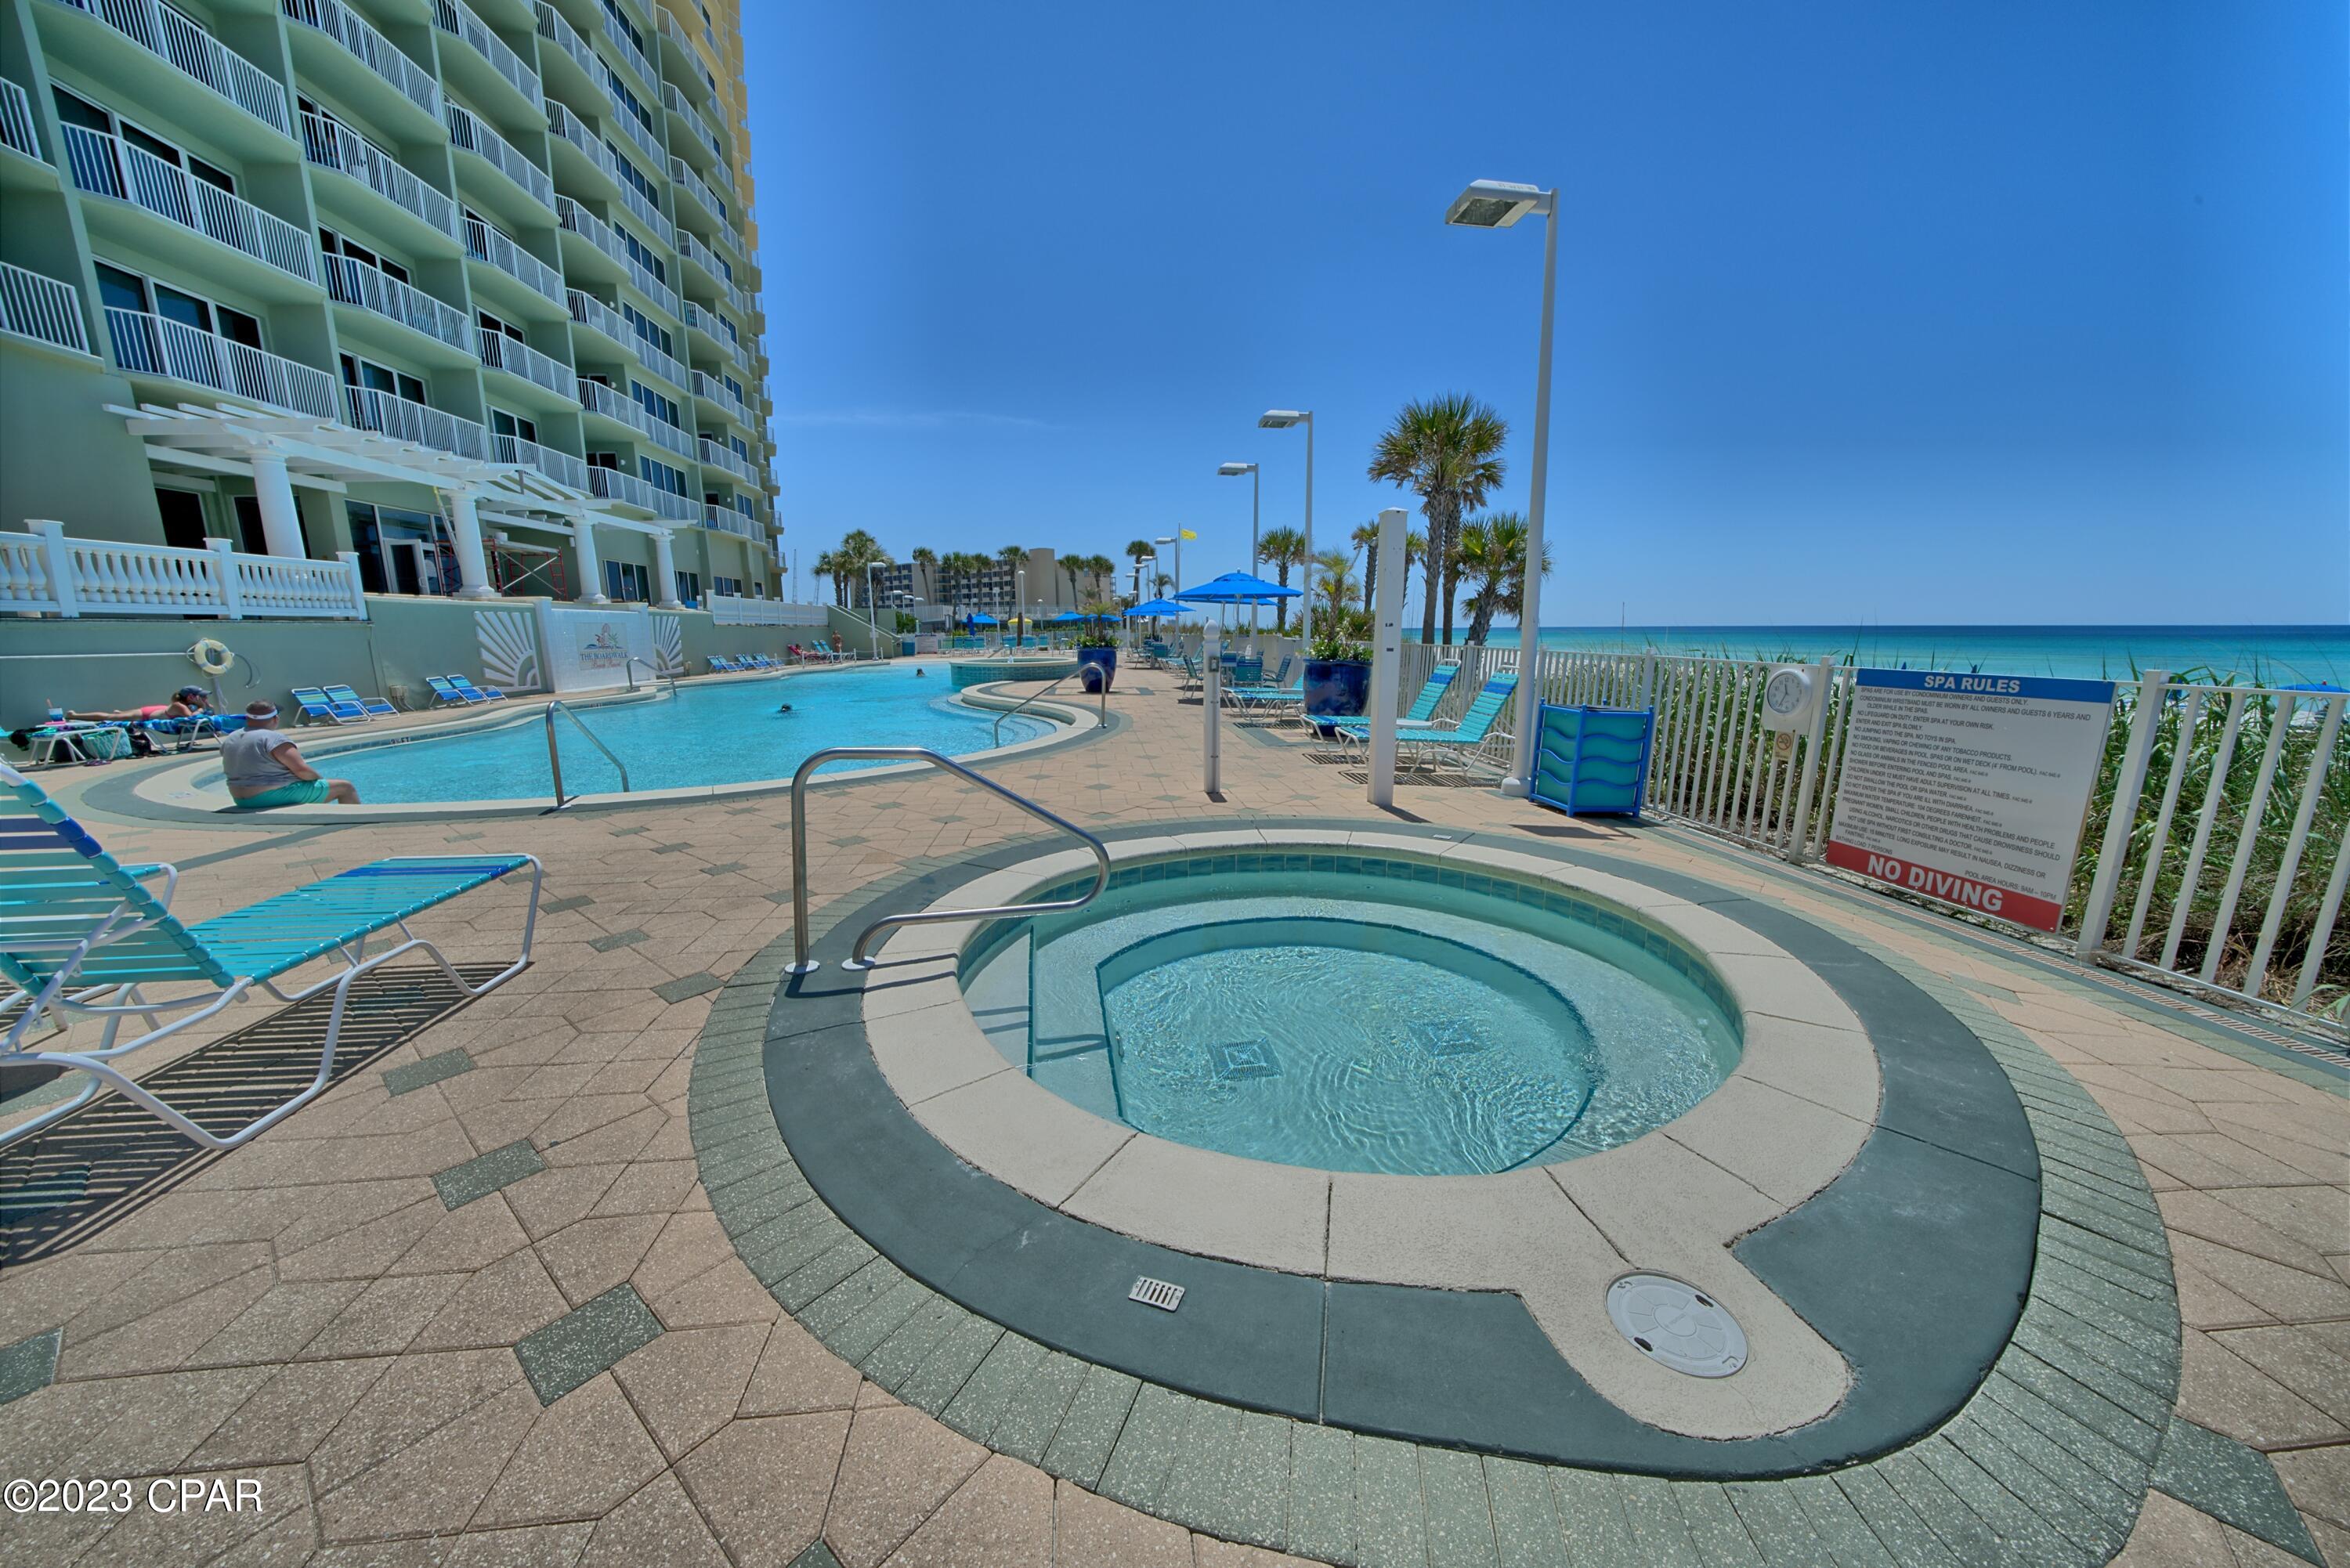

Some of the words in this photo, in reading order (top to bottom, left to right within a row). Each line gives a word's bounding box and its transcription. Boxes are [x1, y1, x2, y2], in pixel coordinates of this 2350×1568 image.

[1924, 674, 1956, 690] SPA
[1961, 677, 2021, 694] RULES
[1879, 746, 1907, 755] BEVERAGES
[1908, 741, 1932, 750] CHEWING
[1952, 747, 1979, 756] TOBACCO
[1979, 751, 2012, 761] PRODUCTS.
[1916, 760, 1937, 768] FENCED
[1847, 765, 1869, 774] CHILDREN
[1936, 781, 1972, 793] SUPERVISION
[1885, 815, 1912, 826] NARCOTICS
[1921, 823, 1938, 832] OTHER
[1939, 827, 1958, 836] DRUGS
[1972, 835, 1993, 844] CAUSE
[1993, 840, 2034, 854] DROWSINESS
[2034, 849, 2061, 861] SHOULD
[1867, 854, 1902, 880] NO
[1907, 867, 2004, 912] DIVING
